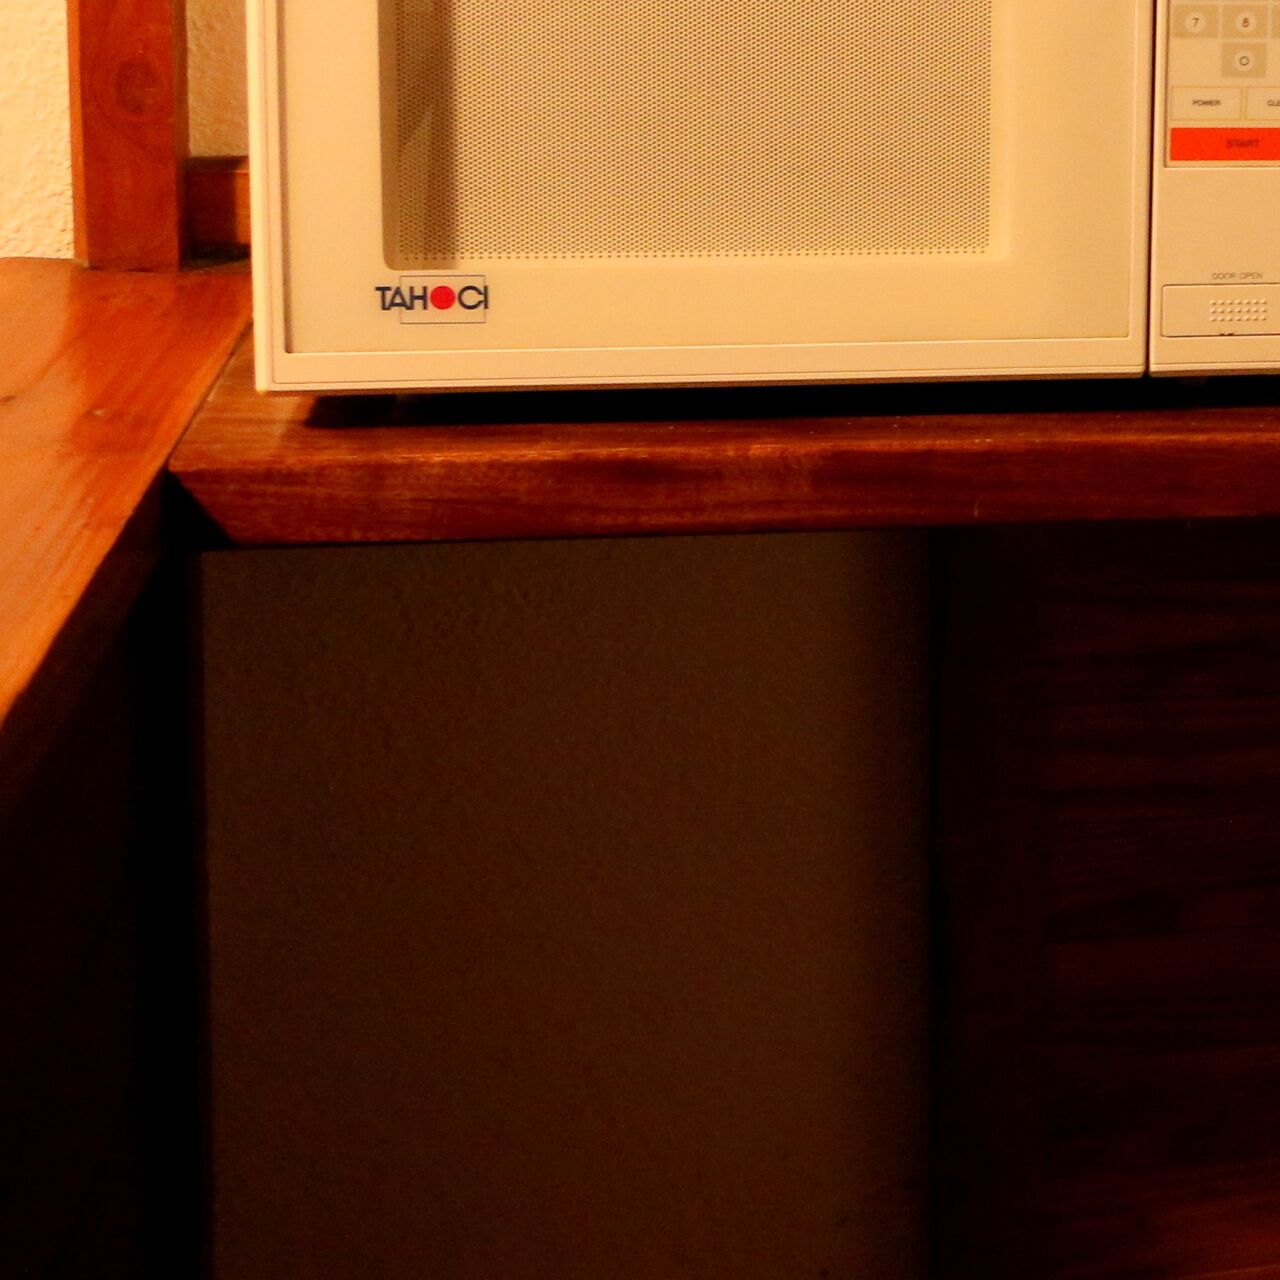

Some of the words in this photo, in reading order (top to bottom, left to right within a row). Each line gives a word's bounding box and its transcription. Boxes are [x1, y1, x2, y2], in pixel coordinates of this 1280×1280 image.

[1192, 17, 1199, 27] 7
[1242, 18, 1249, 28] 8
[1239, 55, 1250, 66] 0
[1191, 99, 1221, 107] POWER
[1226, 139, 1260, 149] START
